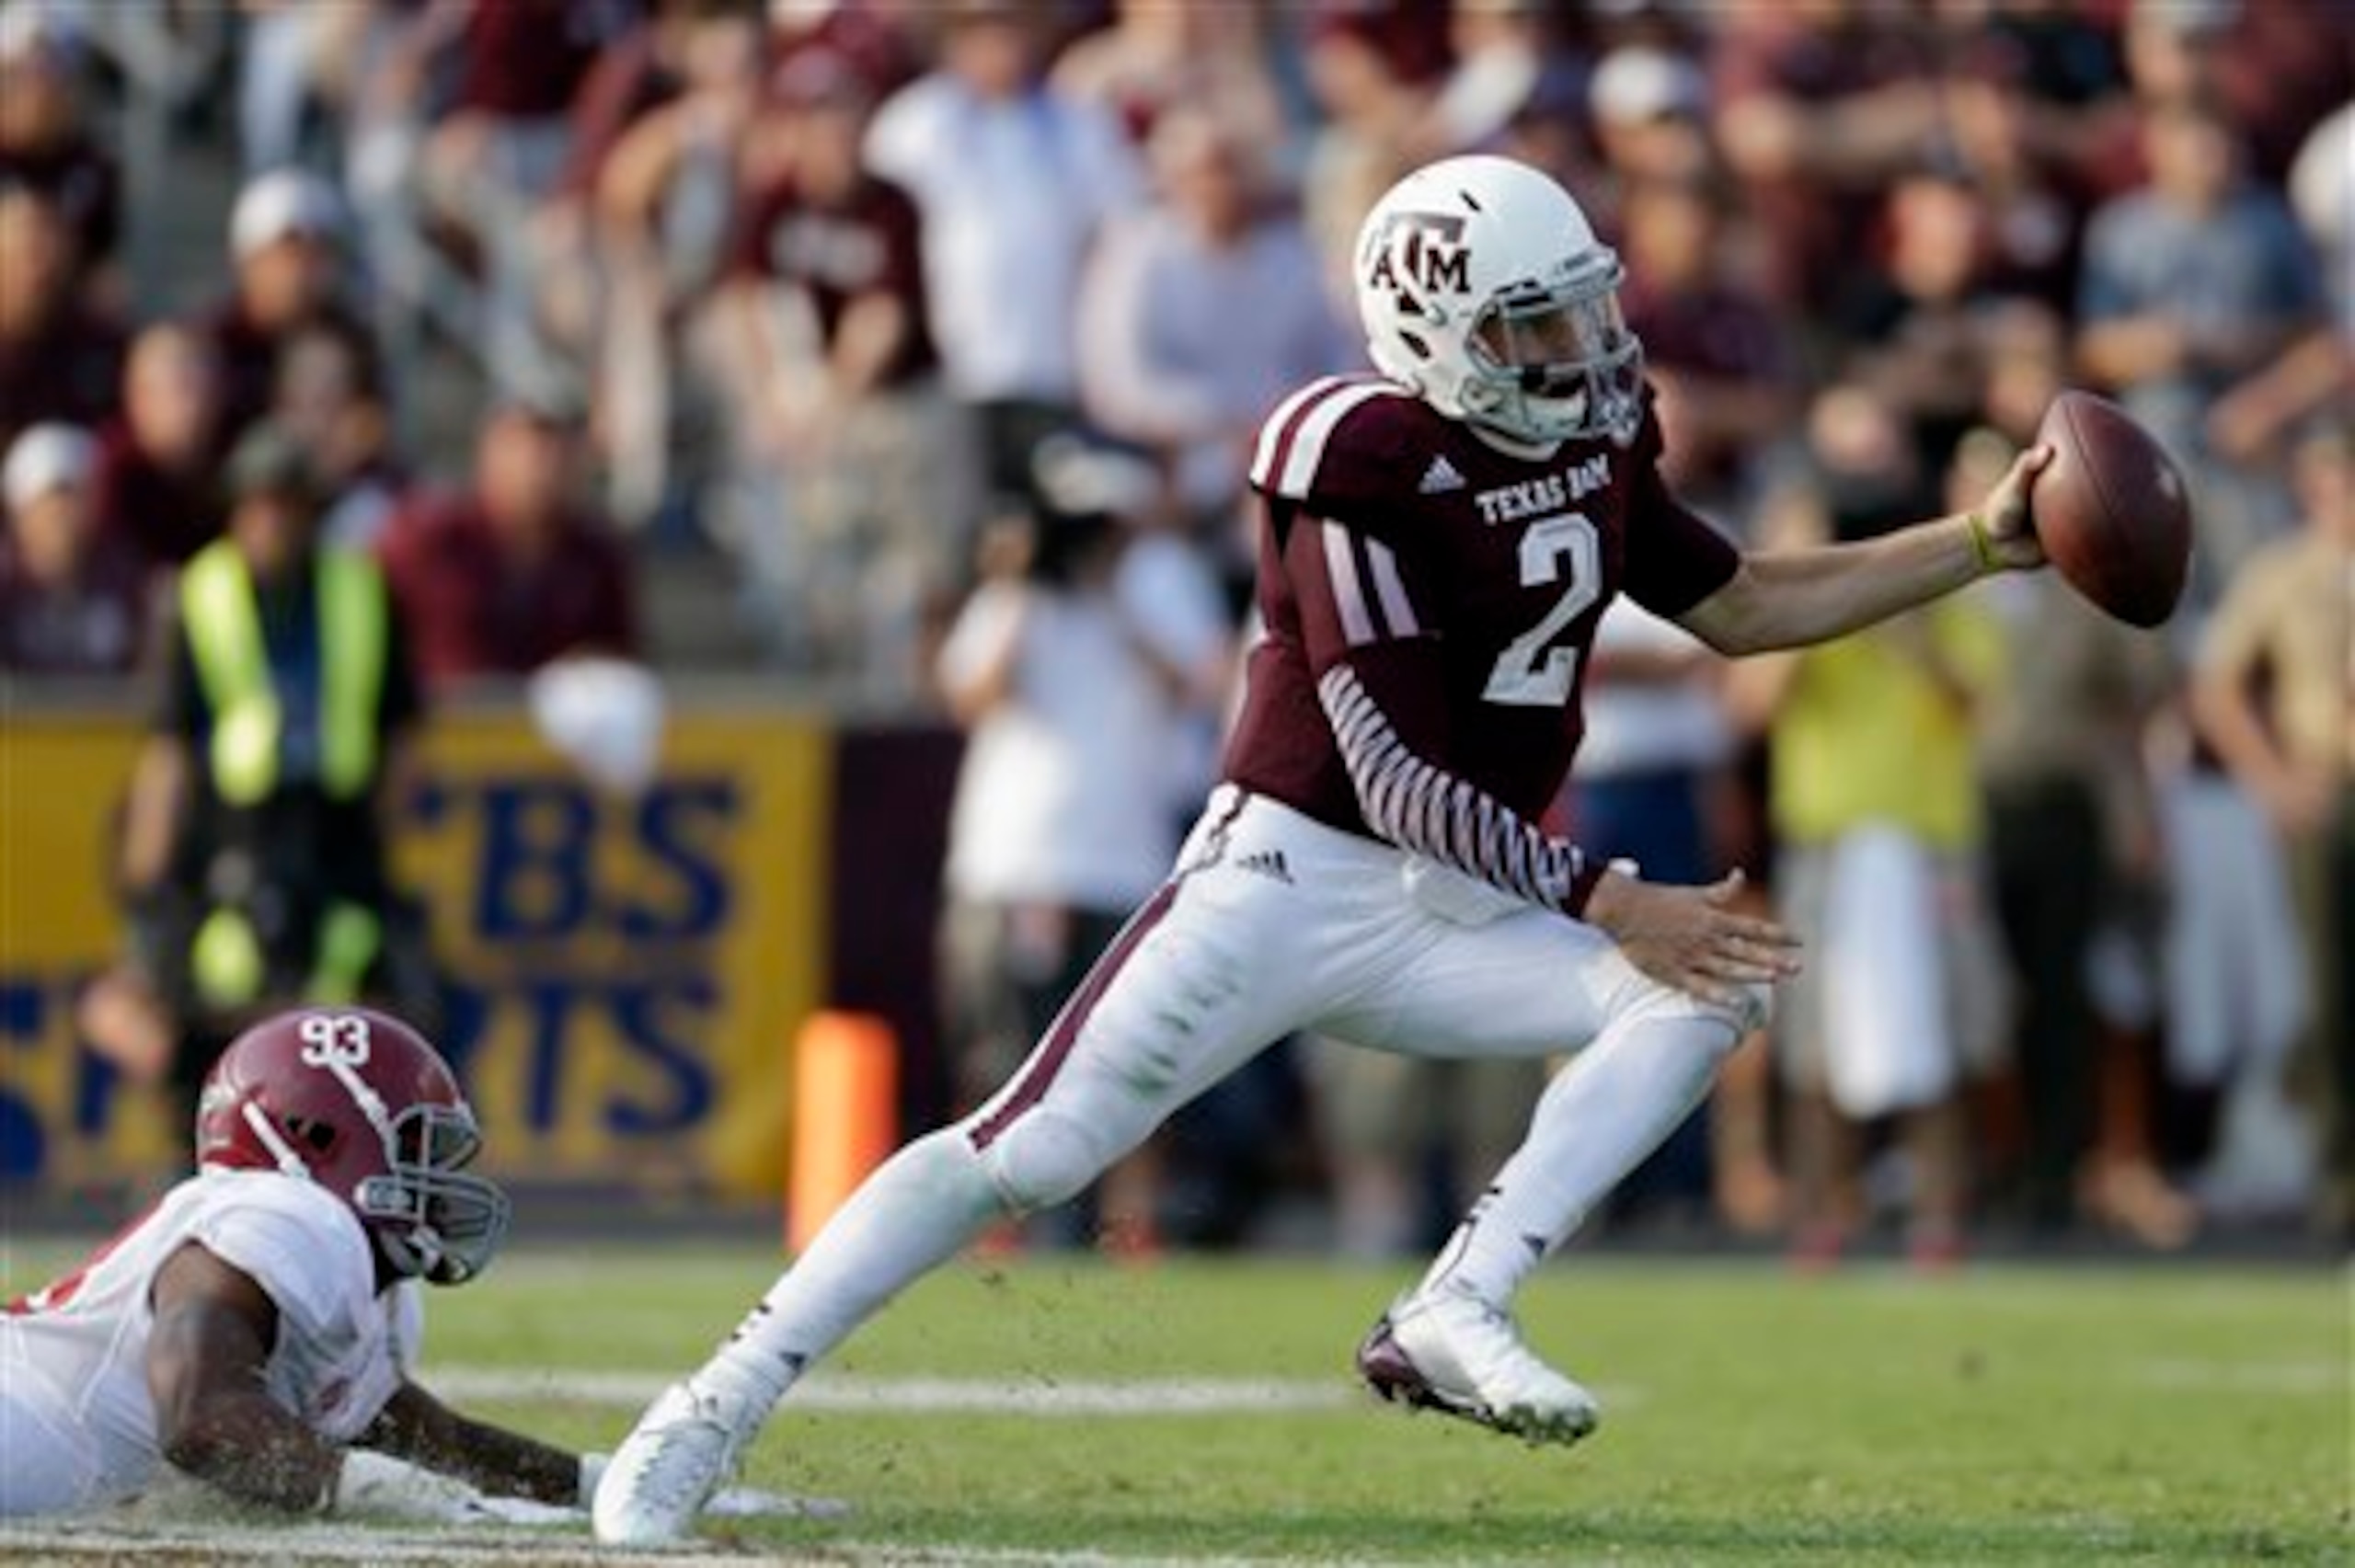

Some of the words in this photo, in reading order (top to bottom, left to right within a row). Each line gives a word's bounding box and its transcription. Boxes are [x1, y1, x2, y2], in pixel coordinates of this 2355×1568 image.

[1475, 475, 1566, 526] TEXAS
[1480, 512, 1602, 706] 2
[301, 1015, 370, 1067] 93
